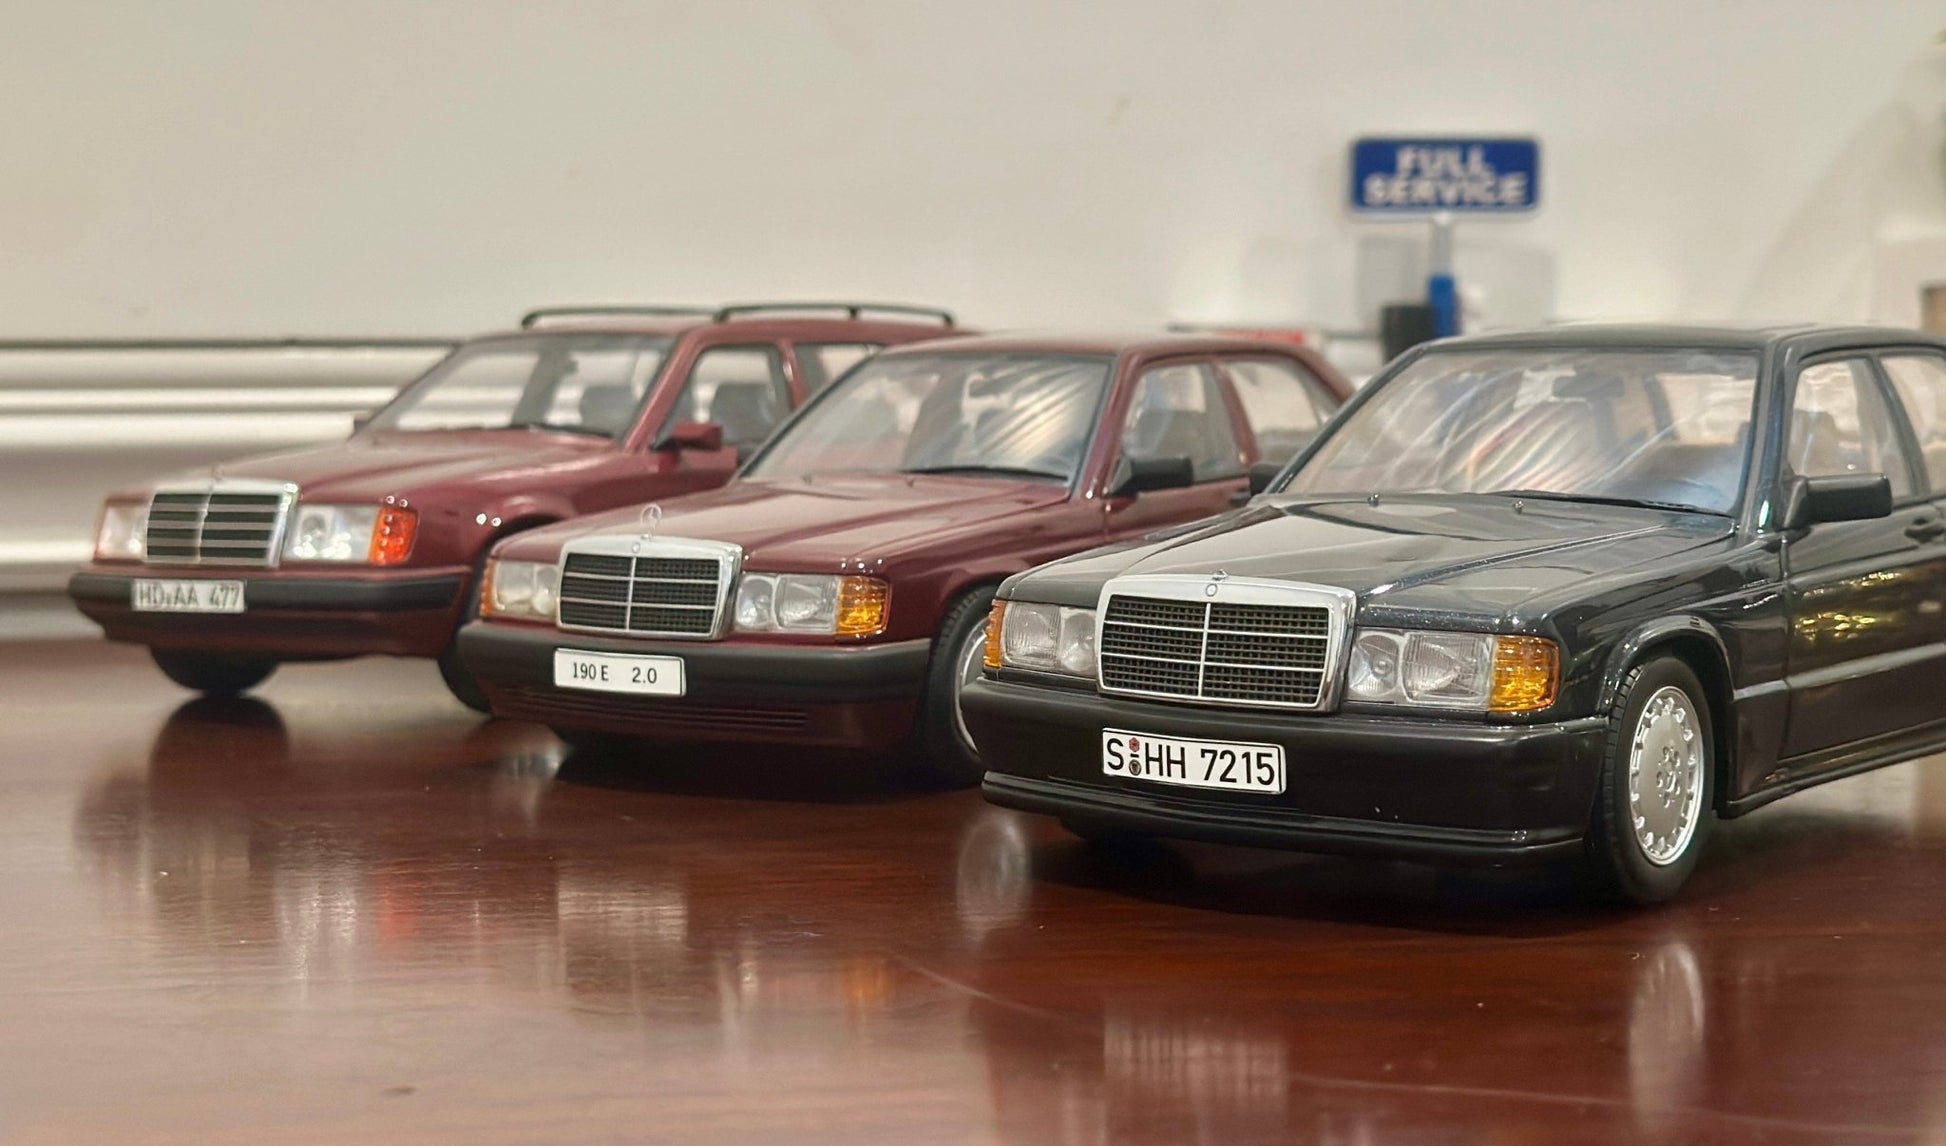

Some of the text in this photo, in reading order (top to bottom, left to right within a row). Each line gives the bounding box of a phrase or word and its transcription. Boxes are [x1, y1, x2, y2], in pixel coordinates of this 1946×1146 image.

[1396, 146, 1494, 174] FULL
[1364, 172, 1527, 205] SERVICE
[632, 666, 657, 684] 2.0
[1200, 749, 1275, 785] 7215
